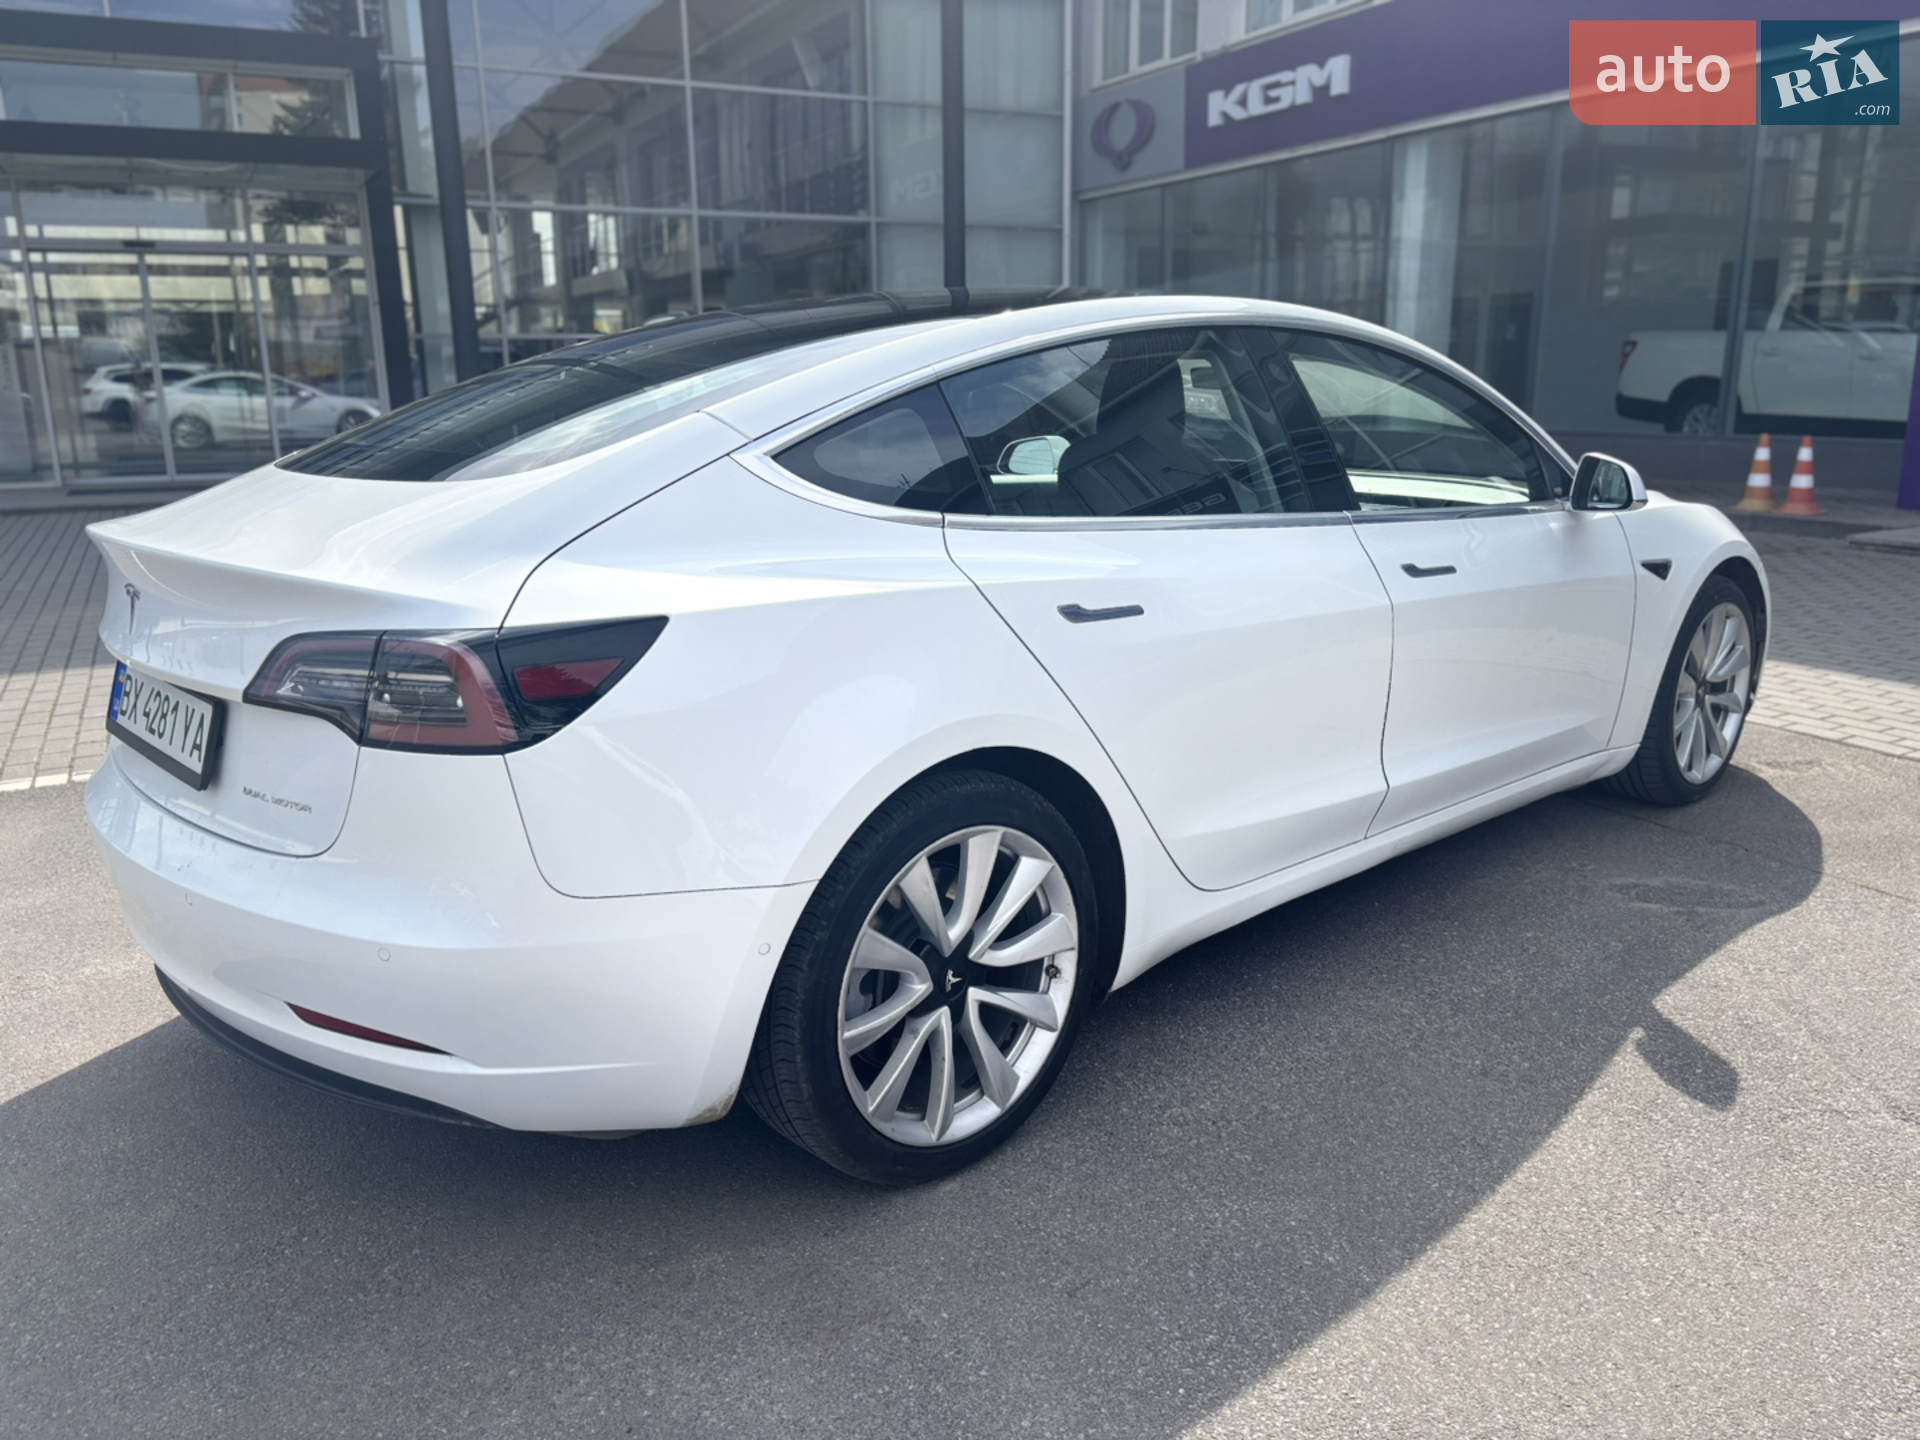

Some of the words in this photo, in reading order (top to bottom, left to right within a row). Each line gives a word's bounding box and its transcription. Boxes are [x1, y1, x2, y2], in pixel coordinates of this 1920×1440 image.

[1207, 54, 1352, 128] KGM
[119, 673, 145, 725] BX
[142, 687, 180, 747] 4281
[181, 704, 206, 764] YA
[243, 786, 270, 803] DUAL
[271, 795, 313, 814] MOTOR
